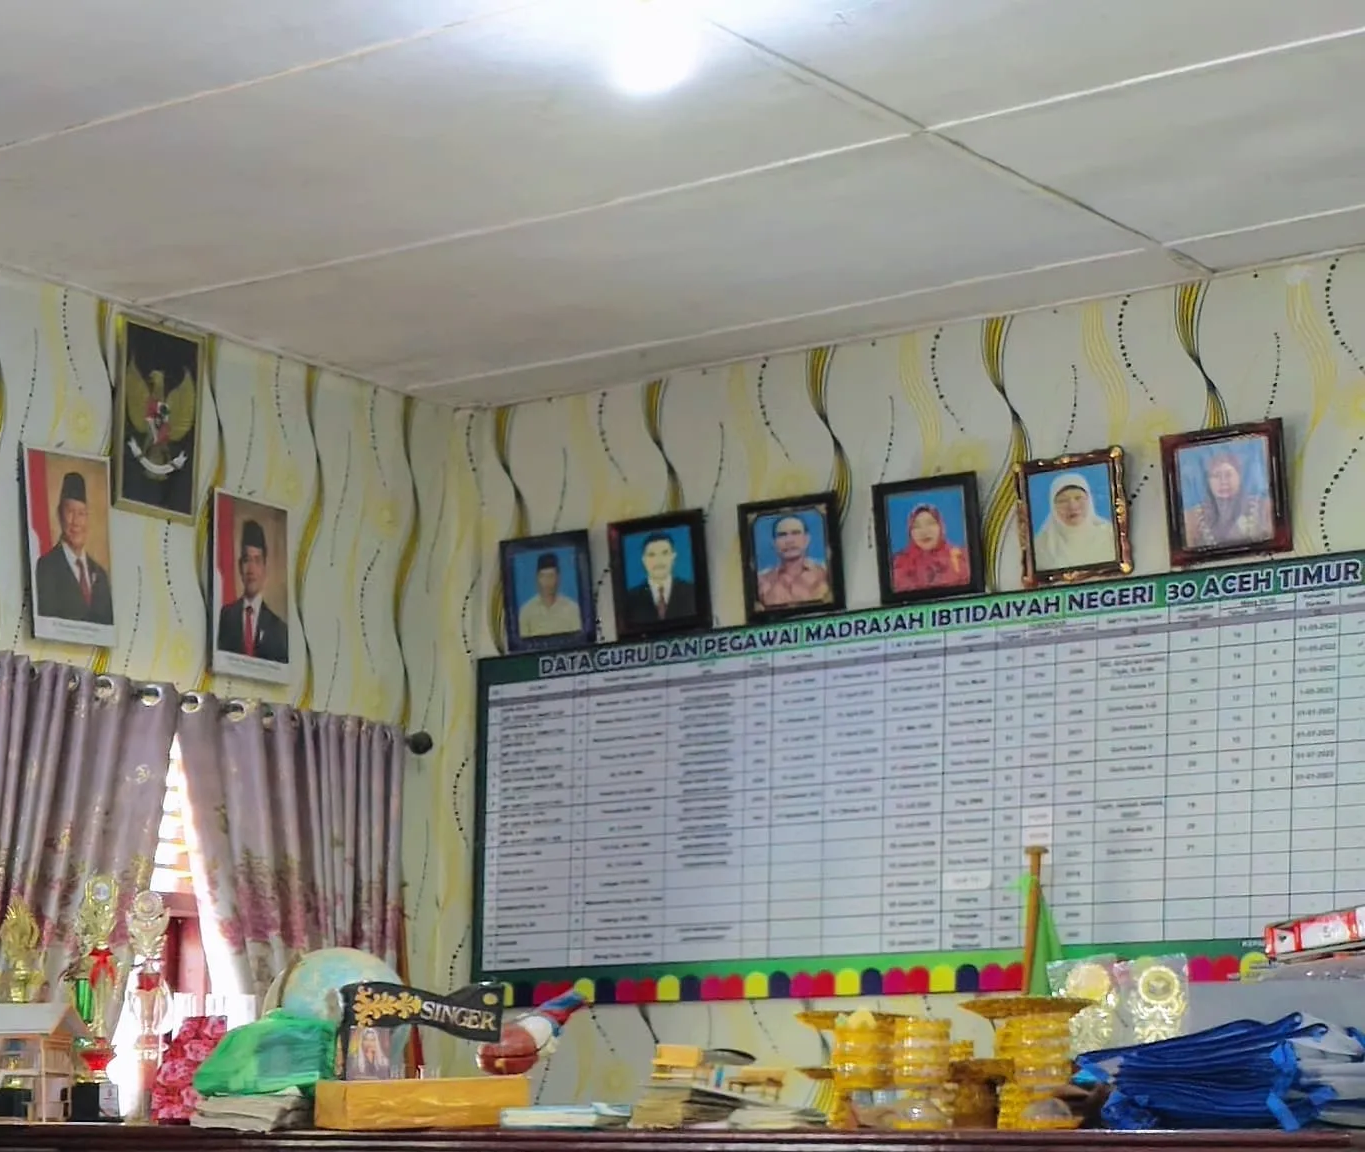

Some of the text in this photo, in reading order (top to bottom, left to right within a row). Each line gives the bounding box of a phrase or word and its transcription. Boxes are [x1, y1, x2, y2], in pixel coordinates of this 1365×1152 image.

[540, 560, 1362, 677] DATA GURU DAN PEGAWAI MADRASAH IBTIDAIYAH NEGERI 30 ACEH TIMUR
[420, 1000, 498, 1032] SINGER
